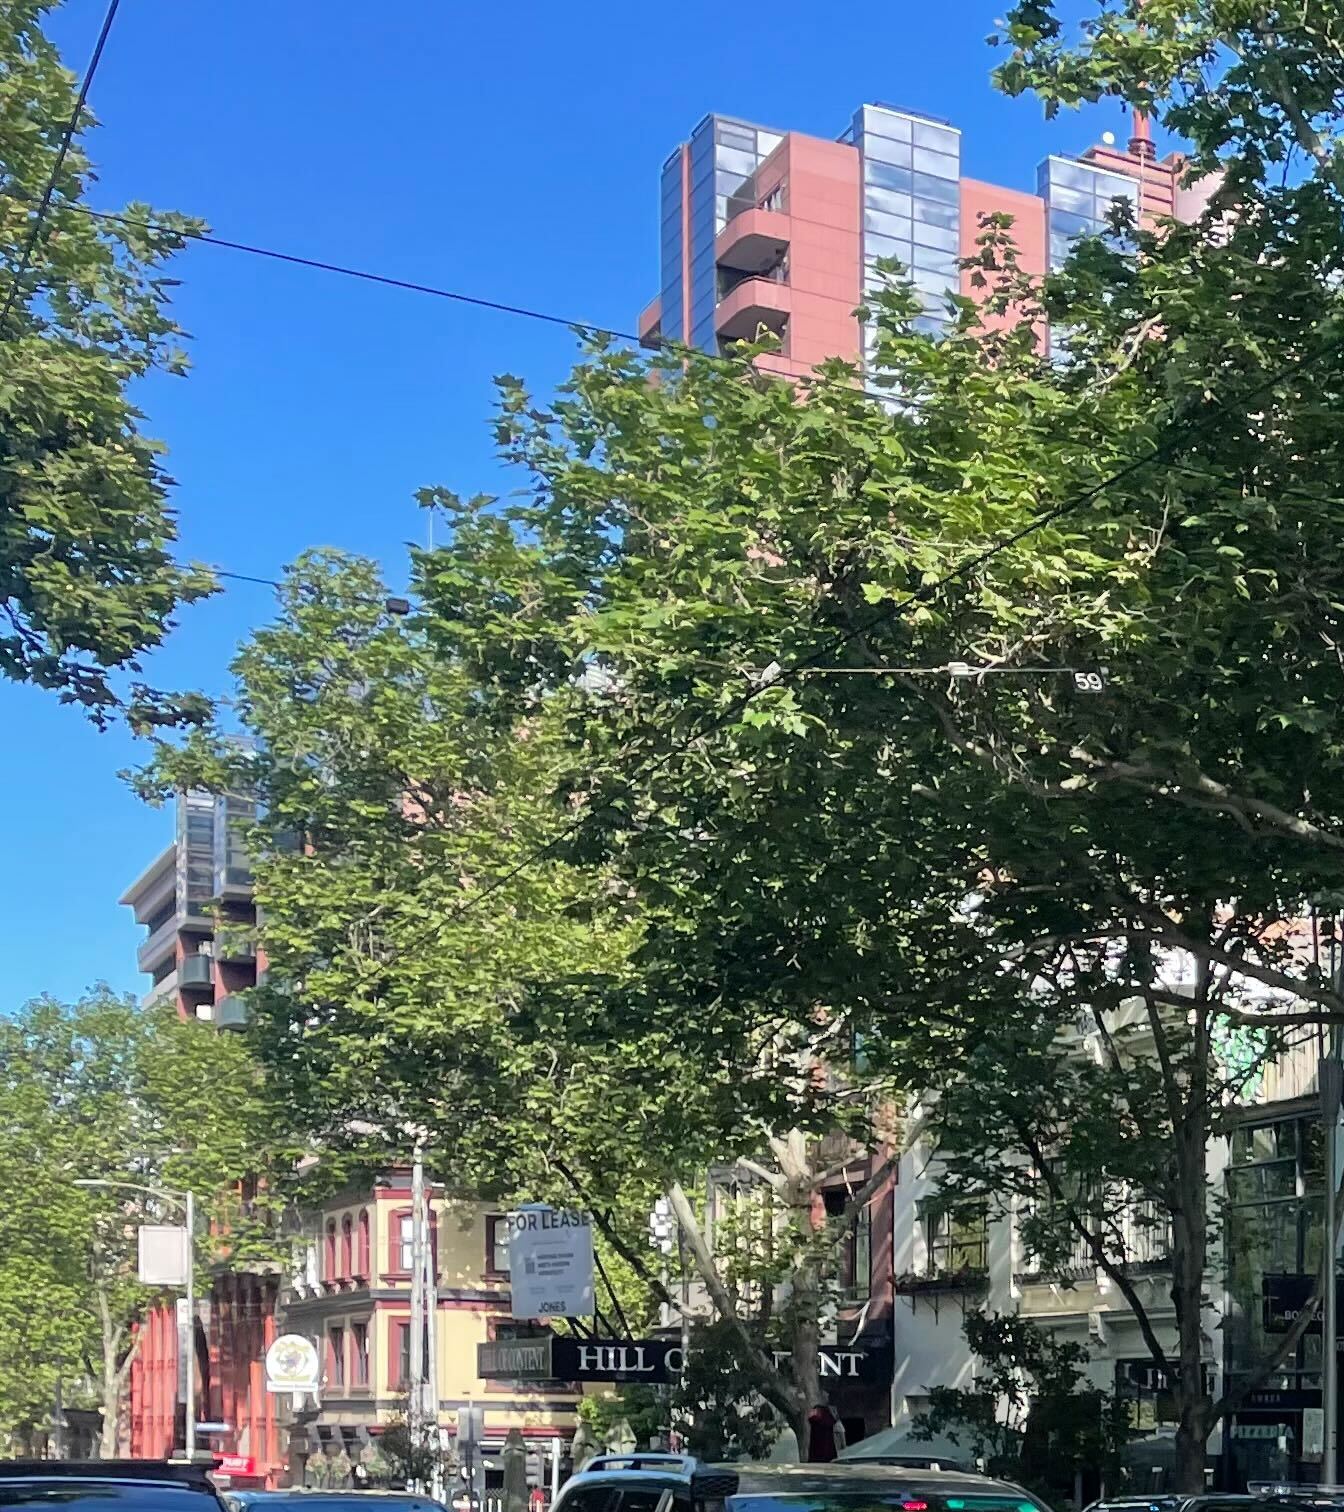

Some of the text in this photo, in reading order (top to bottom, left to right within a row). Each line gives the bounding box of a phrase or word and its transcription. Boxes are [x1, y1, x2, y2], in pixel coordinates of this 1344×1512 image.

[508, 1209, 590, 1231] FOR LEASE
[577, 1346, 655, 1372] HILL
